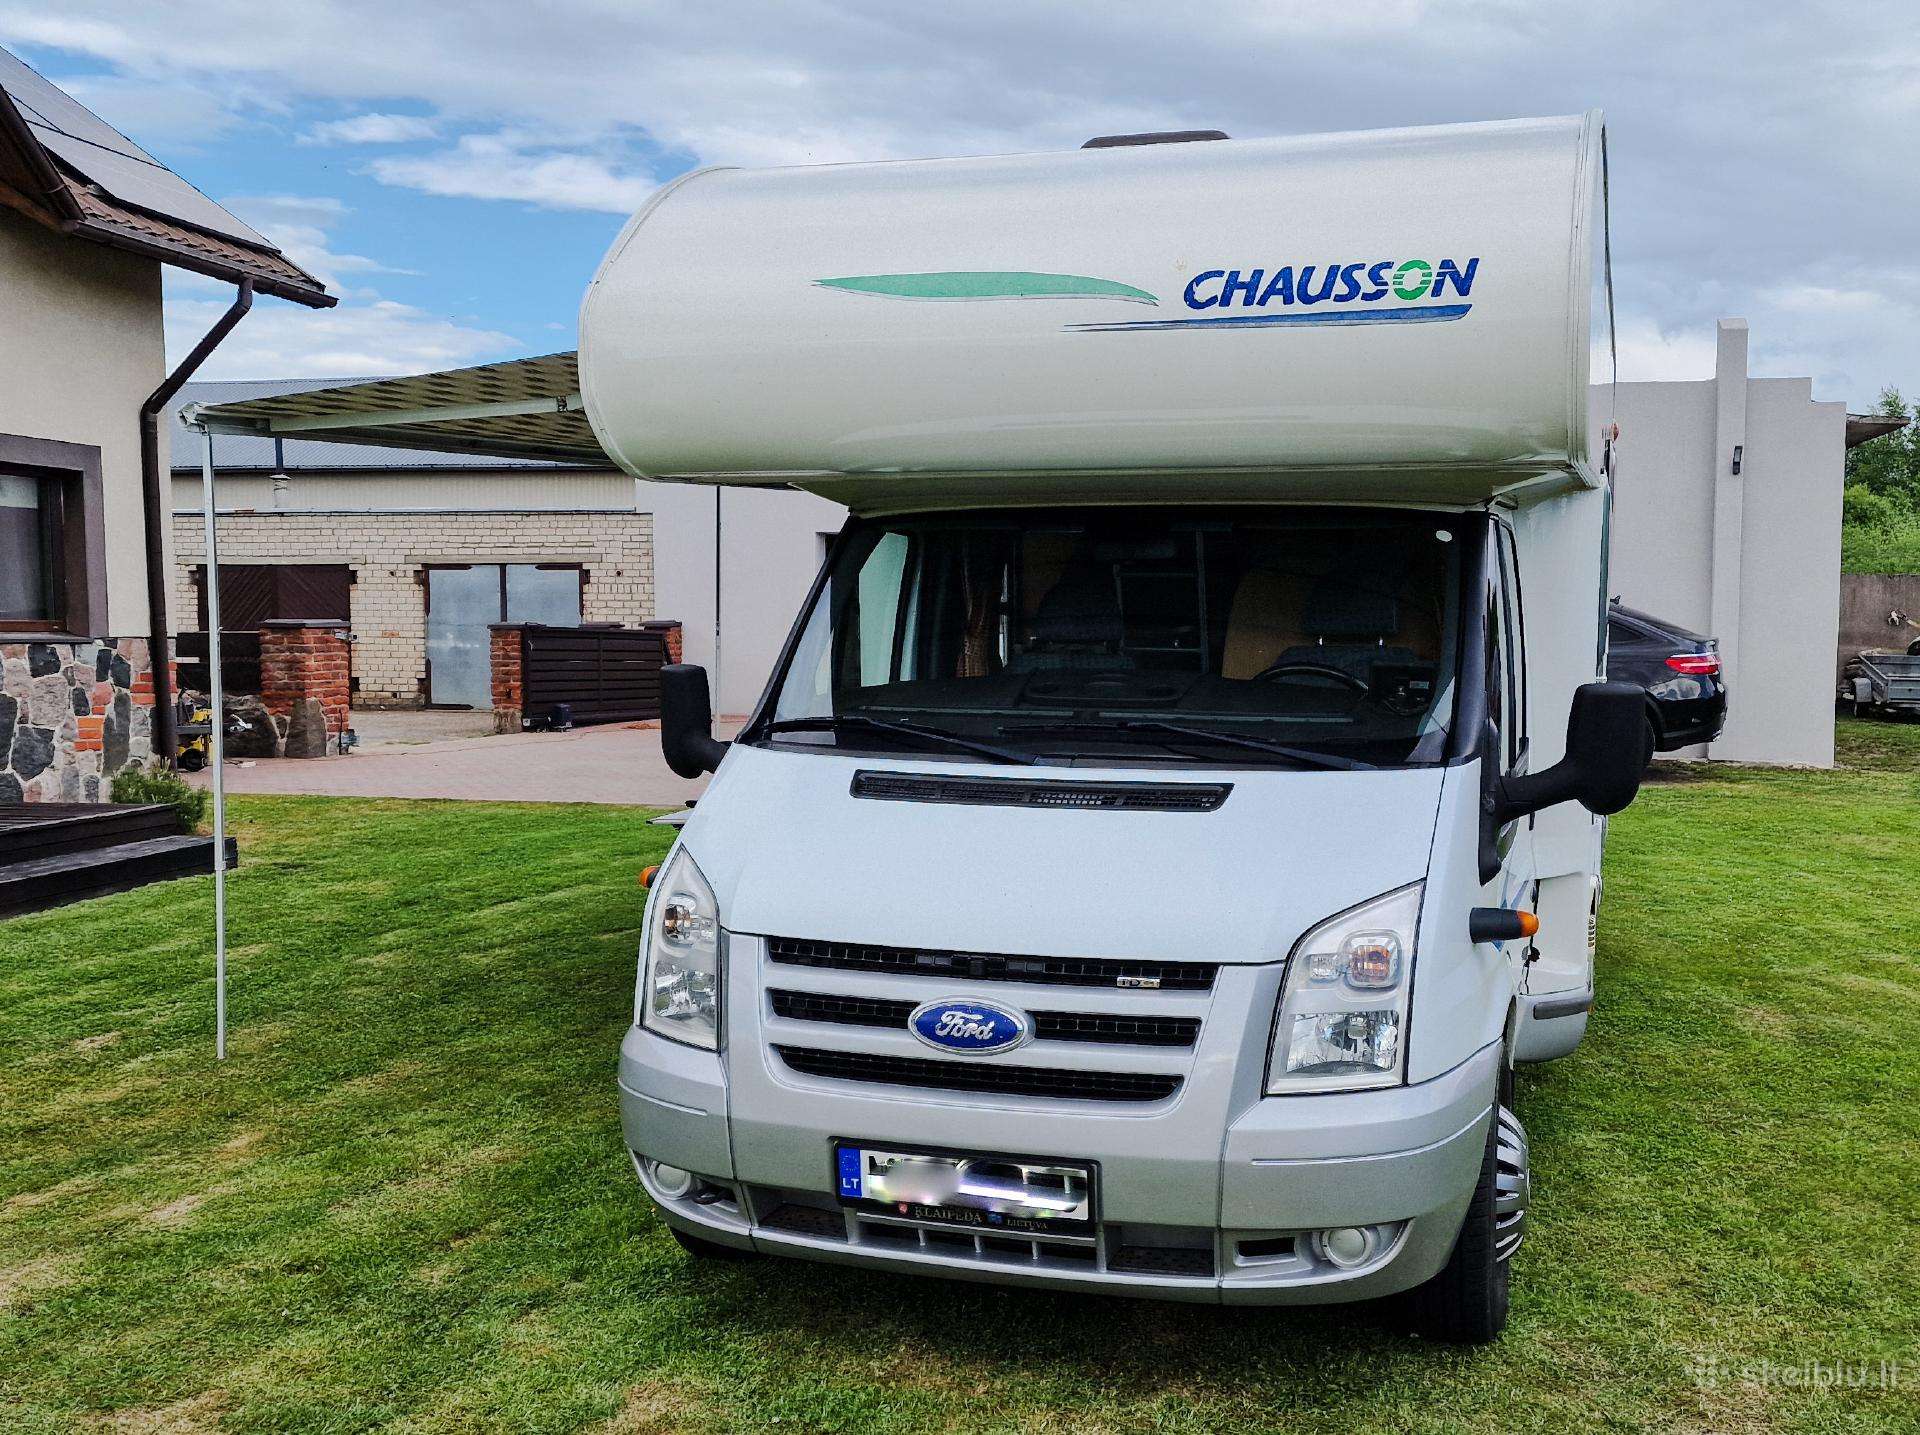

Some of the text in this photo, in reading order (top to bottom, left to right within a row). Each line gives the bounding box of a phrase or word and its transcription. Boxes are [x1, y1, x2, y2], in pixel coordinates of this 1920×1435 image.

[1183, 257, 1479, 309] CHAUSSON
[935, 1011, 994, 1039] Ford
[842, 1178, 859, 1189] LT
